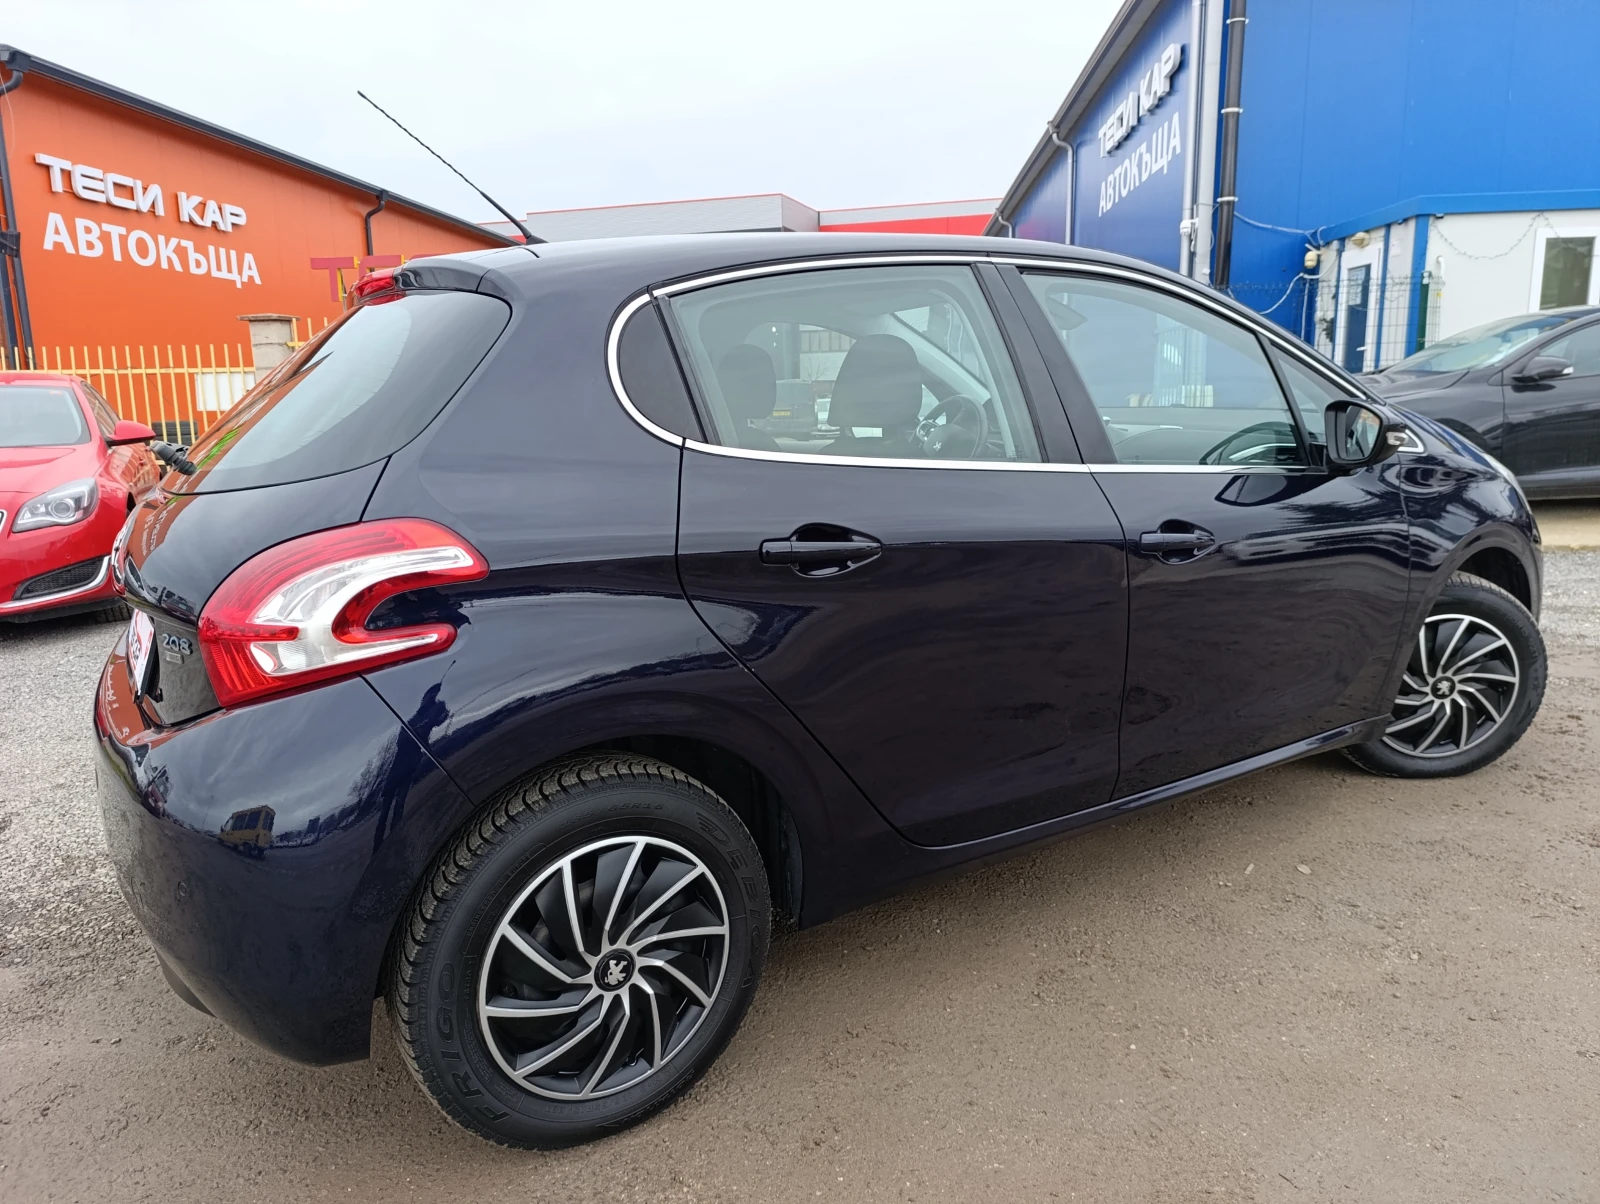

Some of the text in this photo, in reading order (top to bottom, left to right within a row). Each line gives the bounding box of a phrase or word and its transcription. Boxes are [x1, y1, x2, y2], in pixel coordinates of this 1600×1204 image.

[1098, 43, 1182, 158] ТЕСИ КАР
[34, 152, 248, 233] ТЕСИ КАР
[1098, 111, 1182, 218] АВТОКЪЩА
[42, 211, 262, 289] АВТОКЪЩА
[161, 633, 193, 656] 208
[436, 961, 513, 1124] FRIGO
